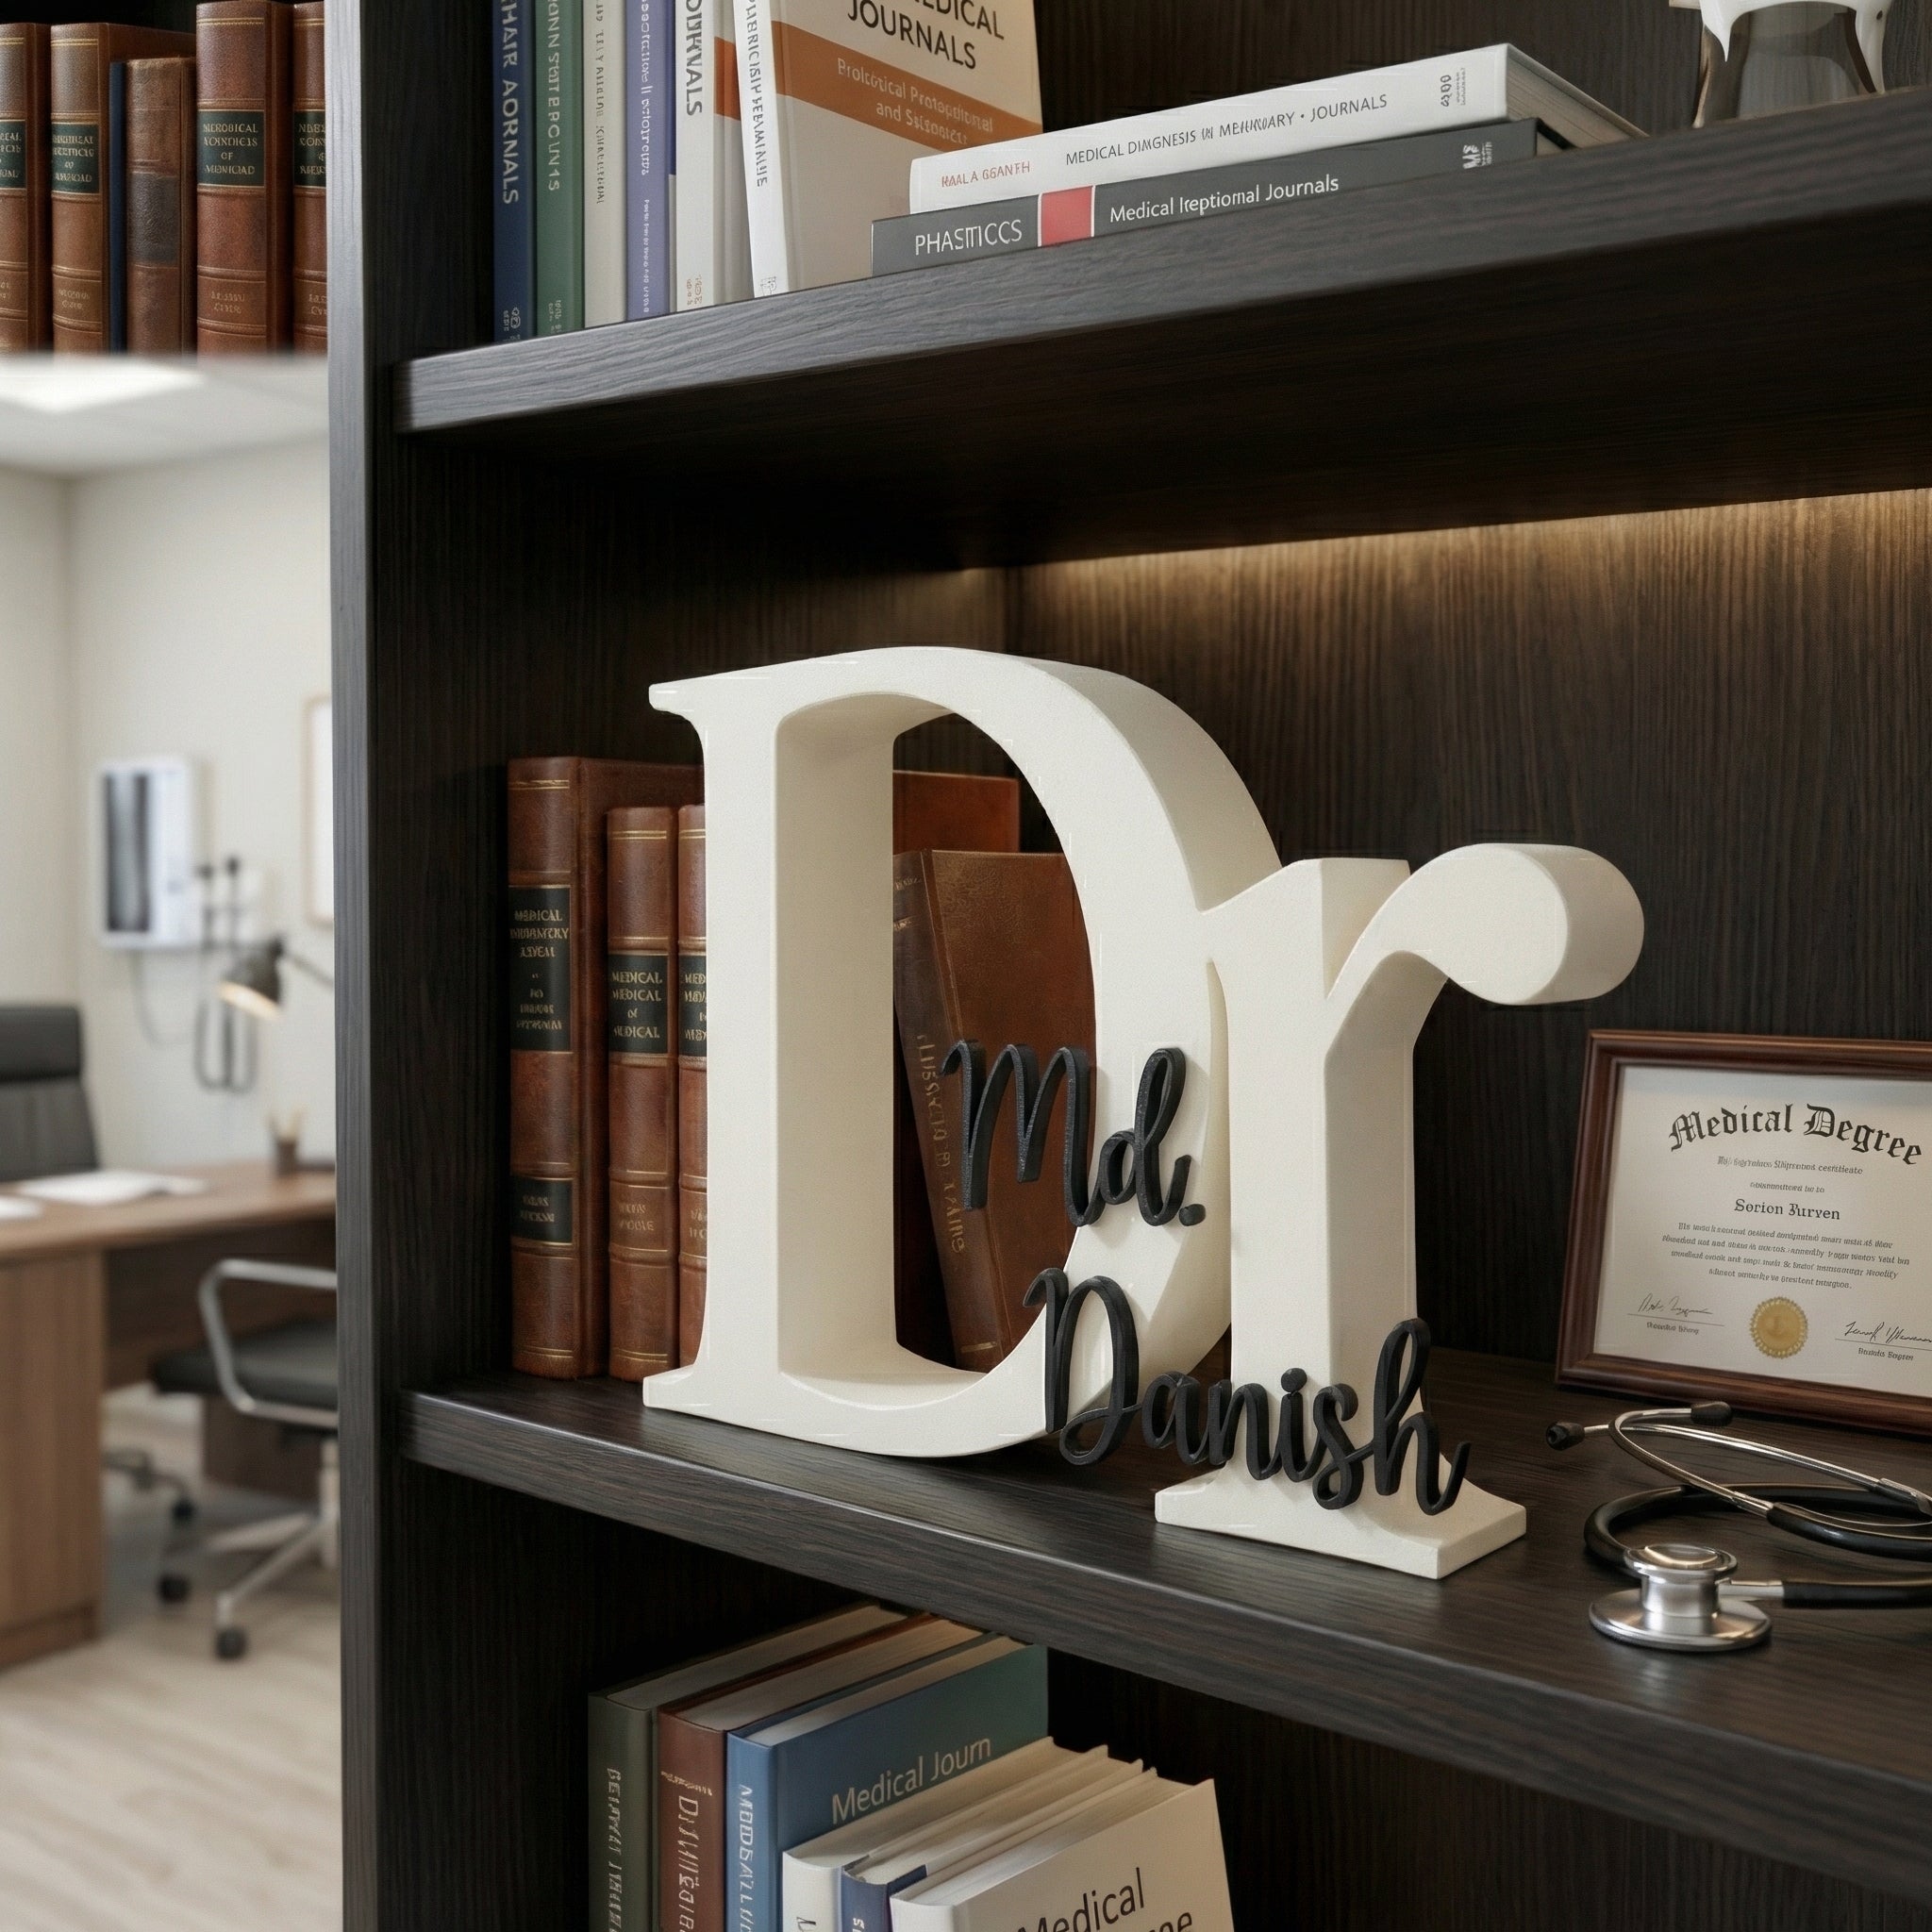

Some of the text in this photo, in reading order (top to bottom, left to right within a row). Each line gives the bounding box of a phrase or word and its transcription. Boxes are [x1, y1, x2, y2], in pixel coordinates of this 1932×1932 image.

[847, 0, 976, 70] JOURNALS
[914, 0, 1005, 40] DICAL
[875, 102, 902, 123] and
[1066, 143, 1124, 165] MEDICAL
[1310, 94, 1388, 123] JOURNALS
[1110, 196, 1174, 223] Medical
[1265, 174, 1340, 201] Journals
[643, 645, 1644, 1579] Dr
[941, 1040, 1207, 1226] Md.
[1669, 1103, 1923, 1165] Medical Degree
[1023, 1268, 1472, 1515] Danish
[832, 1738, 991, 1824] Medical Journ
